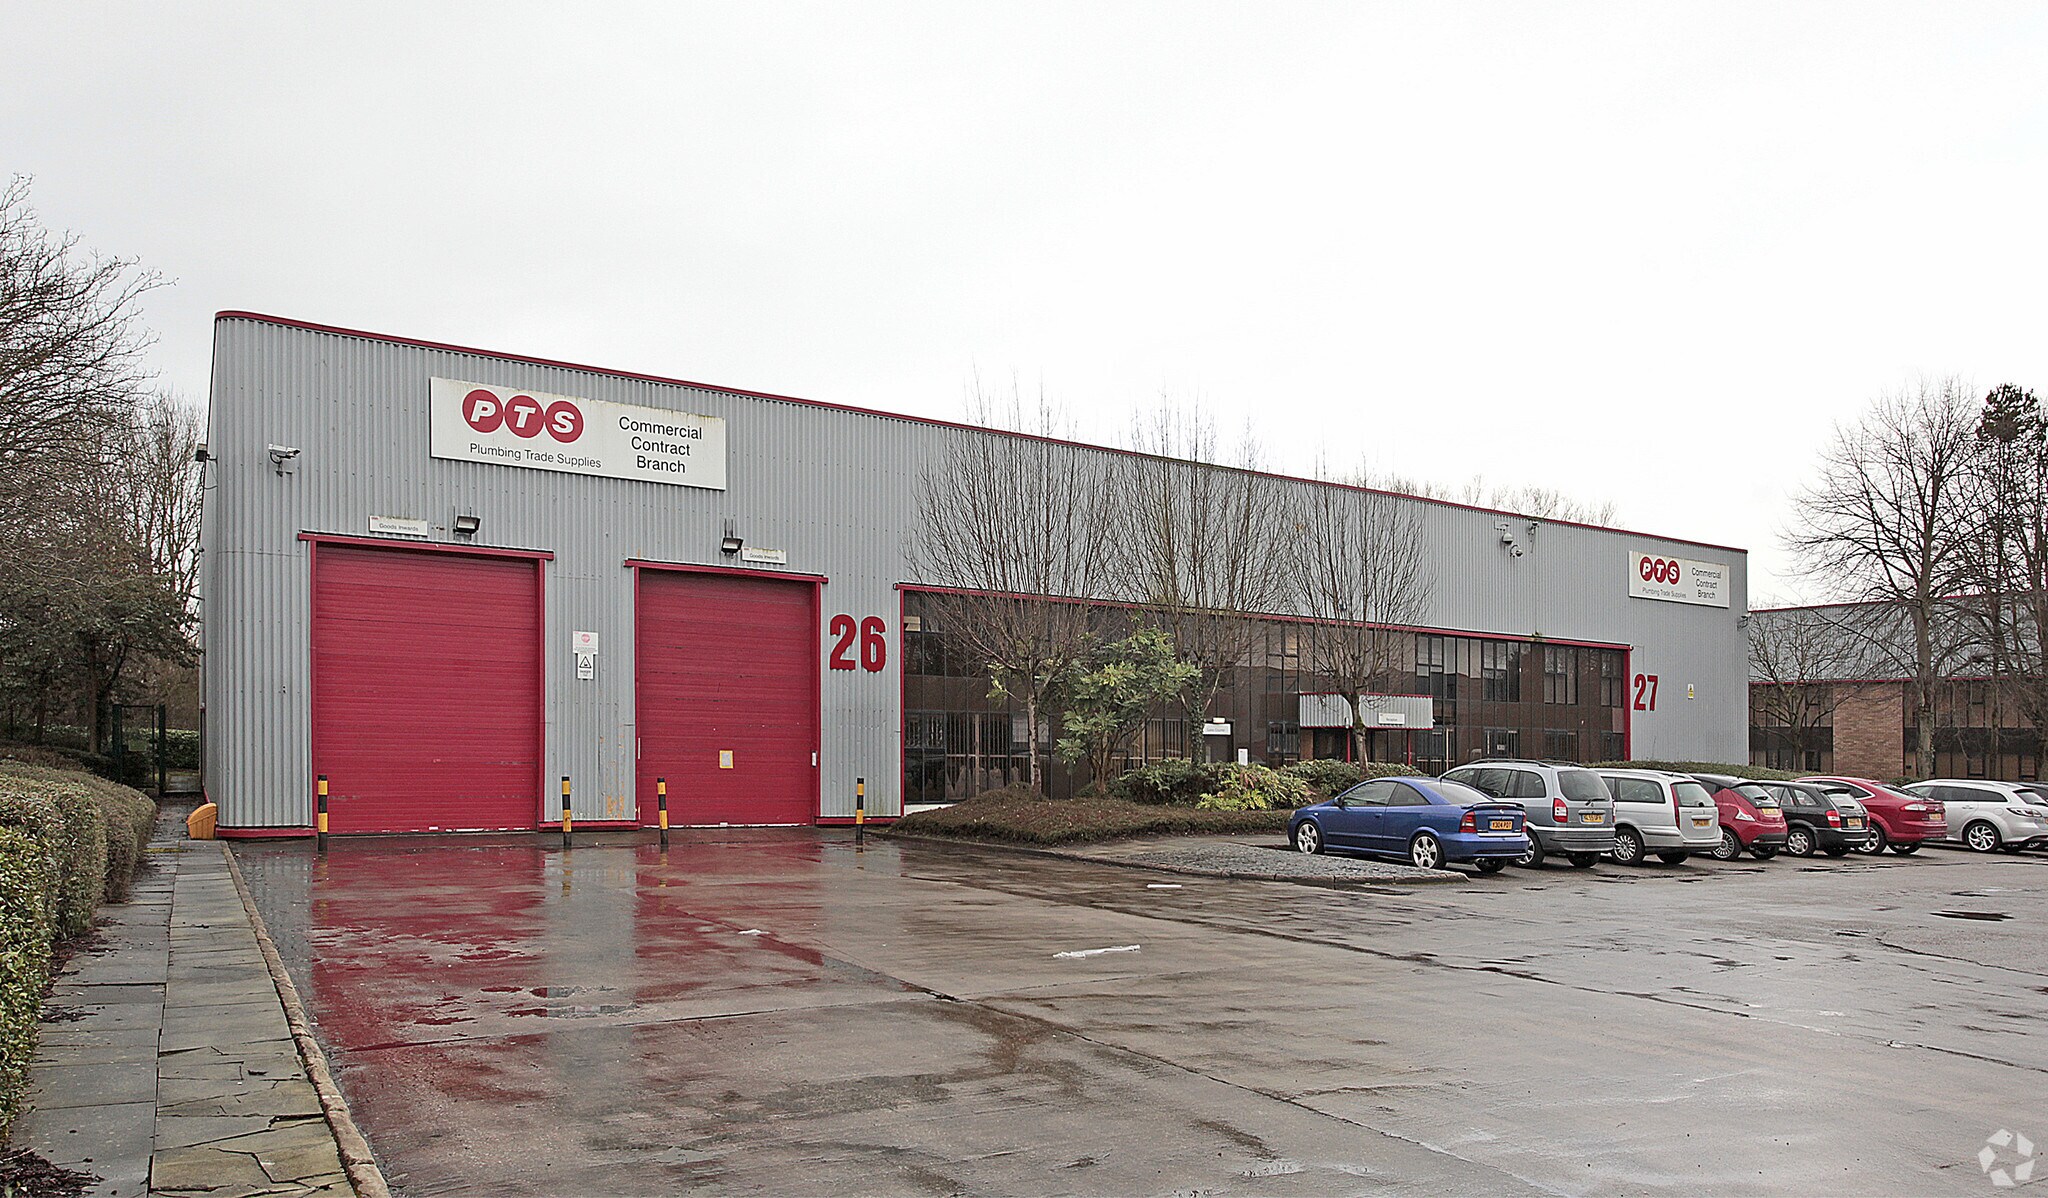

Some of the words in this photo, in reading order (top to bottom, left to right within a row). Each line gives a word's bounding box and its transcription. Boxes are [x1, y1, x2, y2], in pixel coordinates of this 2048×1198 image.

[468, 397, 577, 436] PTS
[618, 416, 703, 440] Commercial
[469, 443, 521, 462] Plumbing
[524, 449, 554, 463] Trade
[556, 453, 602, 468] Supplies
[630, 436, 691, 456] Contract
[636, 455, 686, 474] Branch
[1641, 561, 1678, 581] PTS
[1691, 567, 1722, 579] Commercial
[1695, 578, 1718, 589] Contract
[1697, 589, 1716, 599] Branch
[829, 613, 887, 673] 26
[1633, 673, 1659, 712] 27
